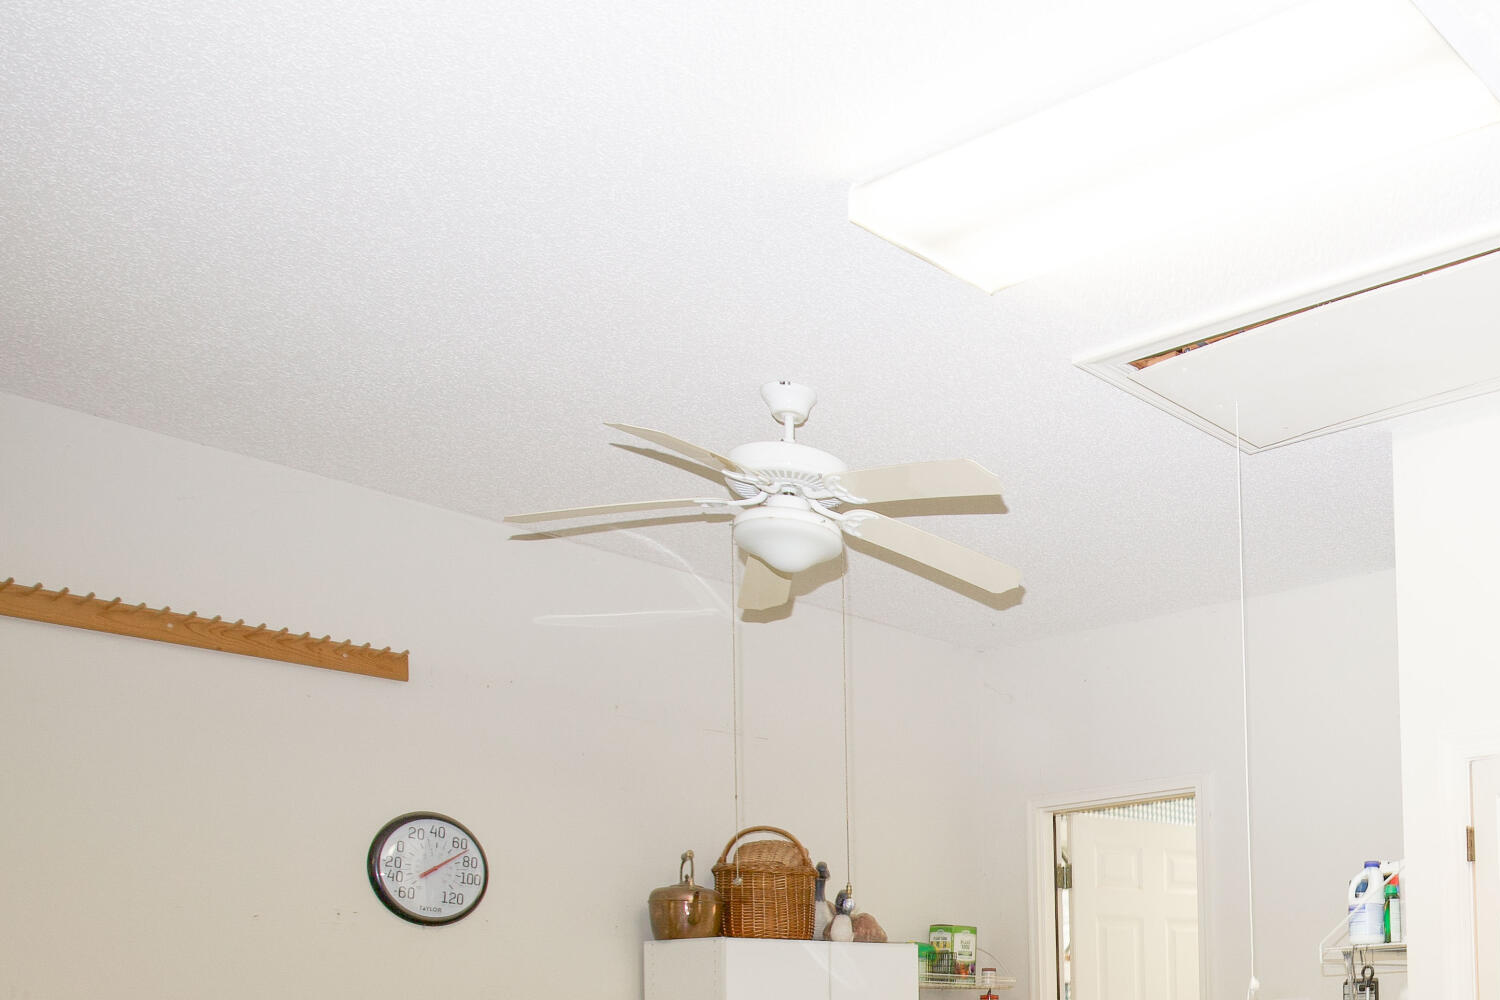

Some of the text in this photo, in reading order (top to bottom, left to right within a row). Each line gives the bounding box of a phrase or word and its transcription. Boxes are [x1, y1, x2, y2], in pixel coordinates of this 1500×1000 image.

[408, 826, 425, 840] 20
[430, 825, 446, 839] 40
[396, 840, 405, 853] 0
[452, 836, 468, 850] 60
[462, 855, 478, 869] 80
[460, 872, 481, 886] 100
[441, 890, 464, 906] 120
